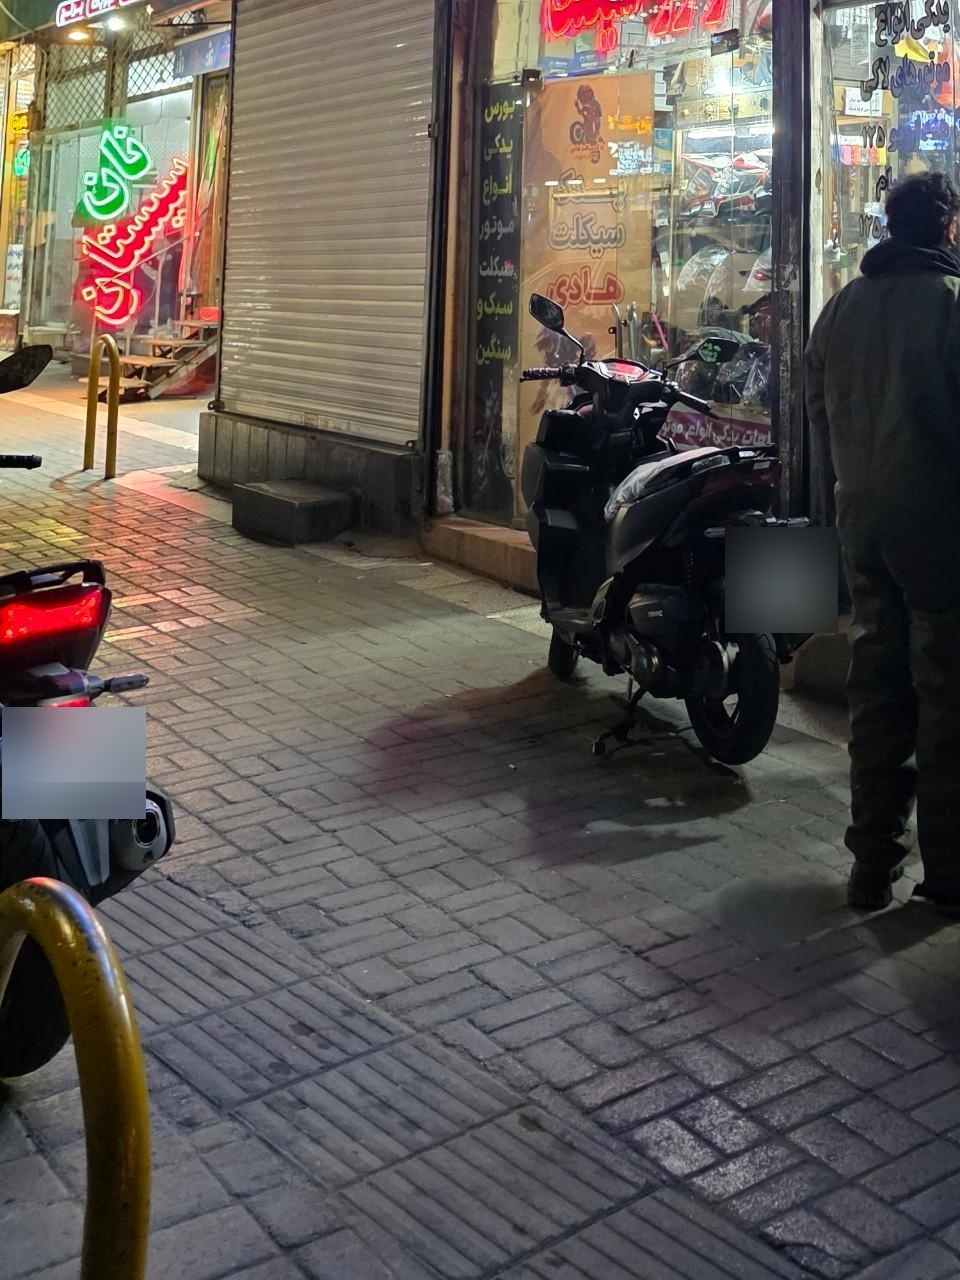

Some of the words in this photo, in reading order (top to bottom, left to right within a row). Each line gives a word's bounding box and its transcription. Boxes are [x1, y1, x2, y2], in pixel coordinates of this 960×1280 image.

[484, 97, 516, 124] بورس
[483, 133, 513, 162] یدکی
[482, 176, 512, 205] انواع
[478, 217, 516, 242] موتور
[549, 211, 625, 259] سیکلت
[475, 339, 512, 367] سنگین
